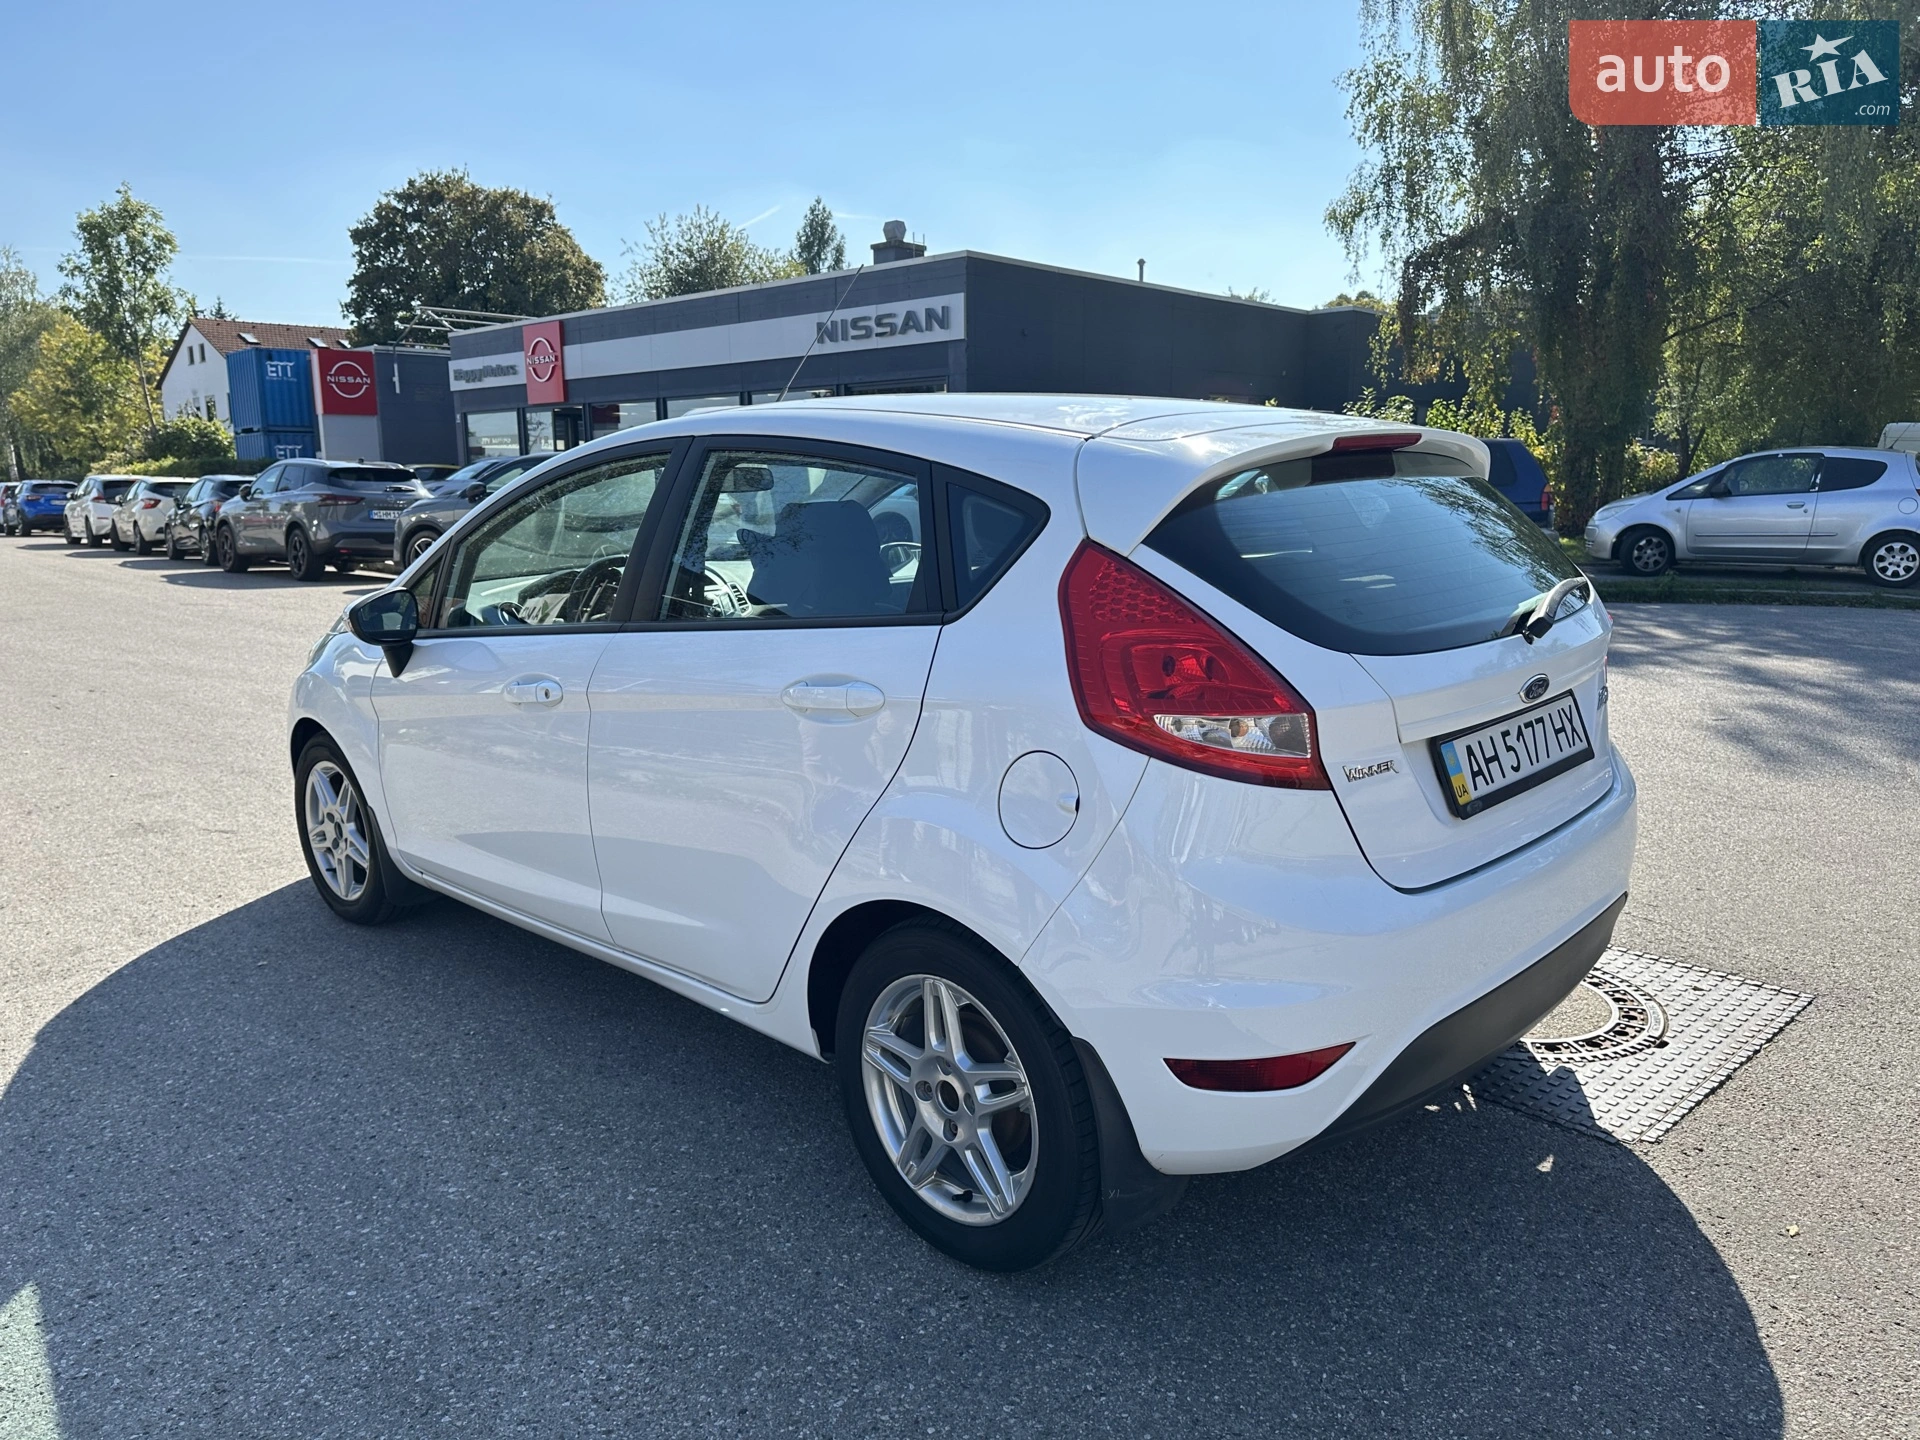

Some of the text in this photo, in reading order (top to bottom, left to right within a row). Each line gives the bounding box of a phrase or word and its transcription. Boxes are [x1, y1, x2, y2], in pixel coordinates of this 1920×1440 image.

[816, 305, 950, 344] NISSAN
[526, 354, 556, 365] NISSAN
[327, 375, 371, 384] NISSAN
[1465, 704, 1584, 791] AH 5177 HX
[1342, 760, 1399, 782] WINNER
[1455, 783, 1469, 798] UA
